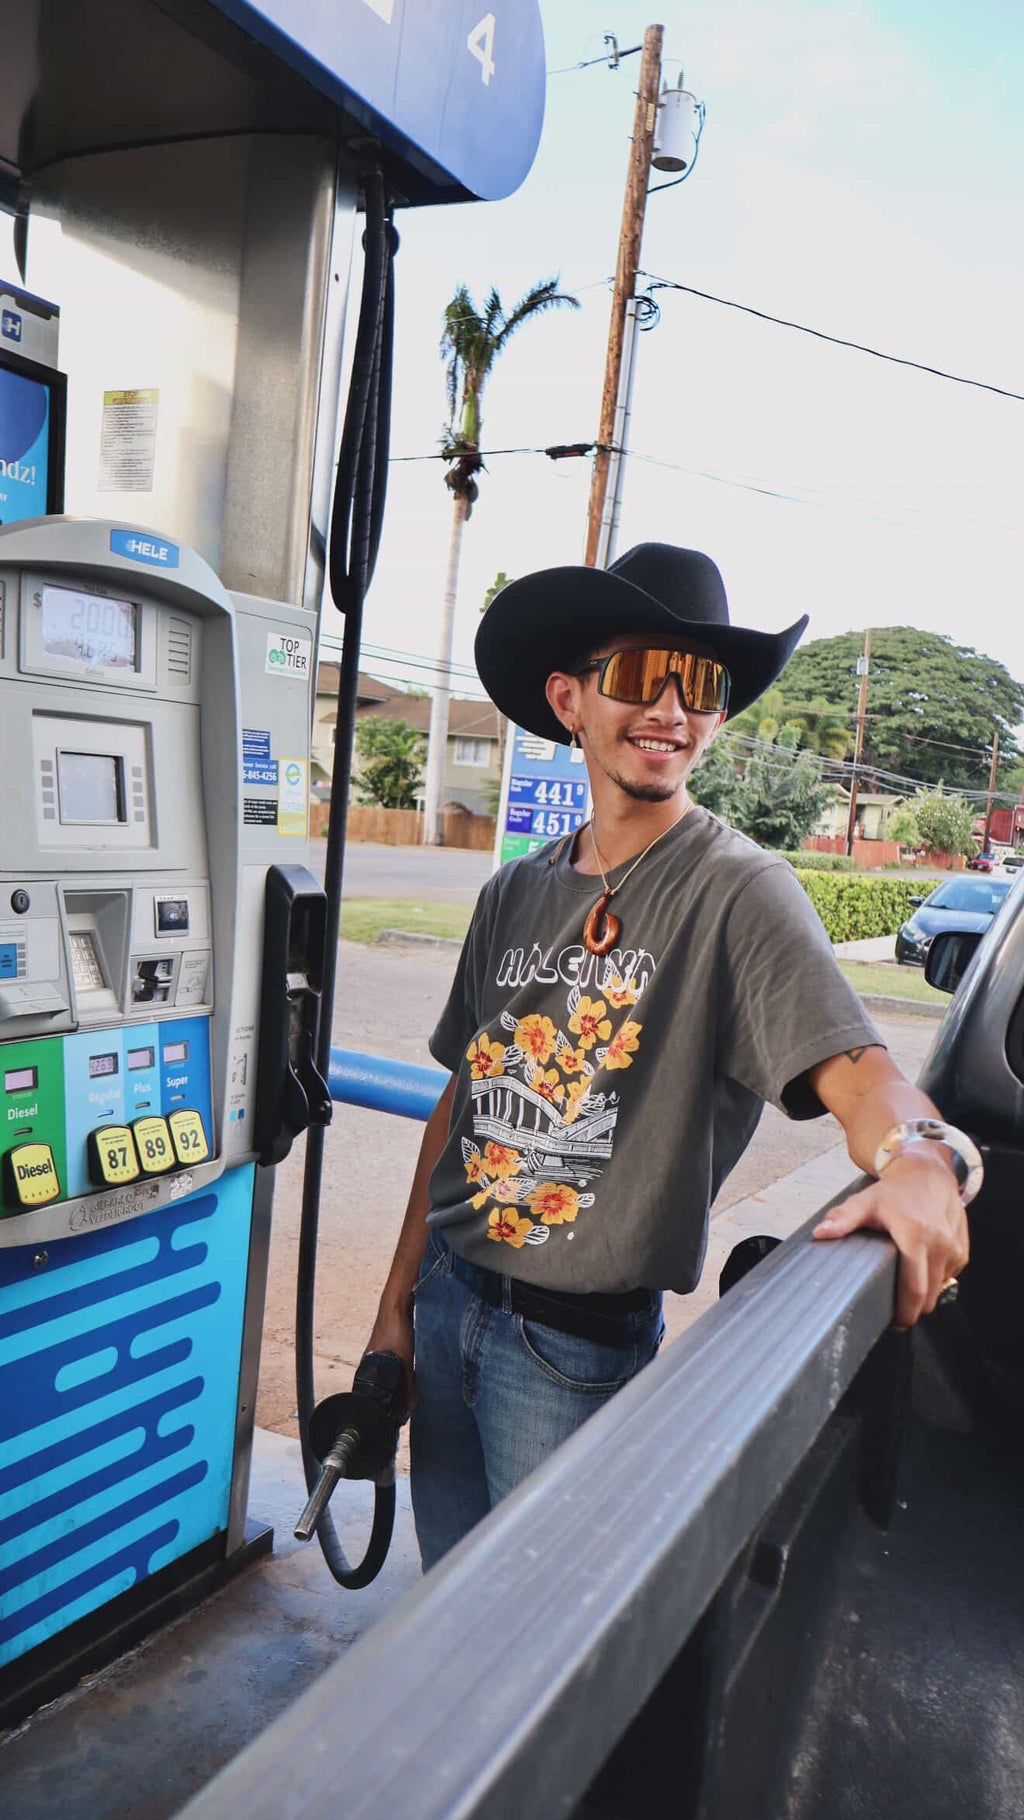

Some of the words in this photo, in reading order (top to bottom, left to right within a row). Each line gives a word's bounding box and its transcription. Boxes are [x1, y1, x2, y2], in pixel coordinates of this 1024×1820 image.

[467, 12, 496, 86] 4
[129, 539, 169, 561] HELE
[33, 591, 42, 610] $
[280, 637, 300, 654] TOP
[286, 653, 307, 669] TIER
[534, 781, 575, 807] 441
[532, 811, 573, 837] 451
[134, 1083, 152, 1093] Plus
[166, 1076, 188, 1089] Super
[88, 1087, 121, 1106] Regular
[7, 1103, 38, 1120] Diesel
[145, 1137, 166, 1159] 89
[180, 1129, 201, 1151] 92
[107, 1146, 127, 1169] 87
[17, 1158, 53, 1181] Diesel
